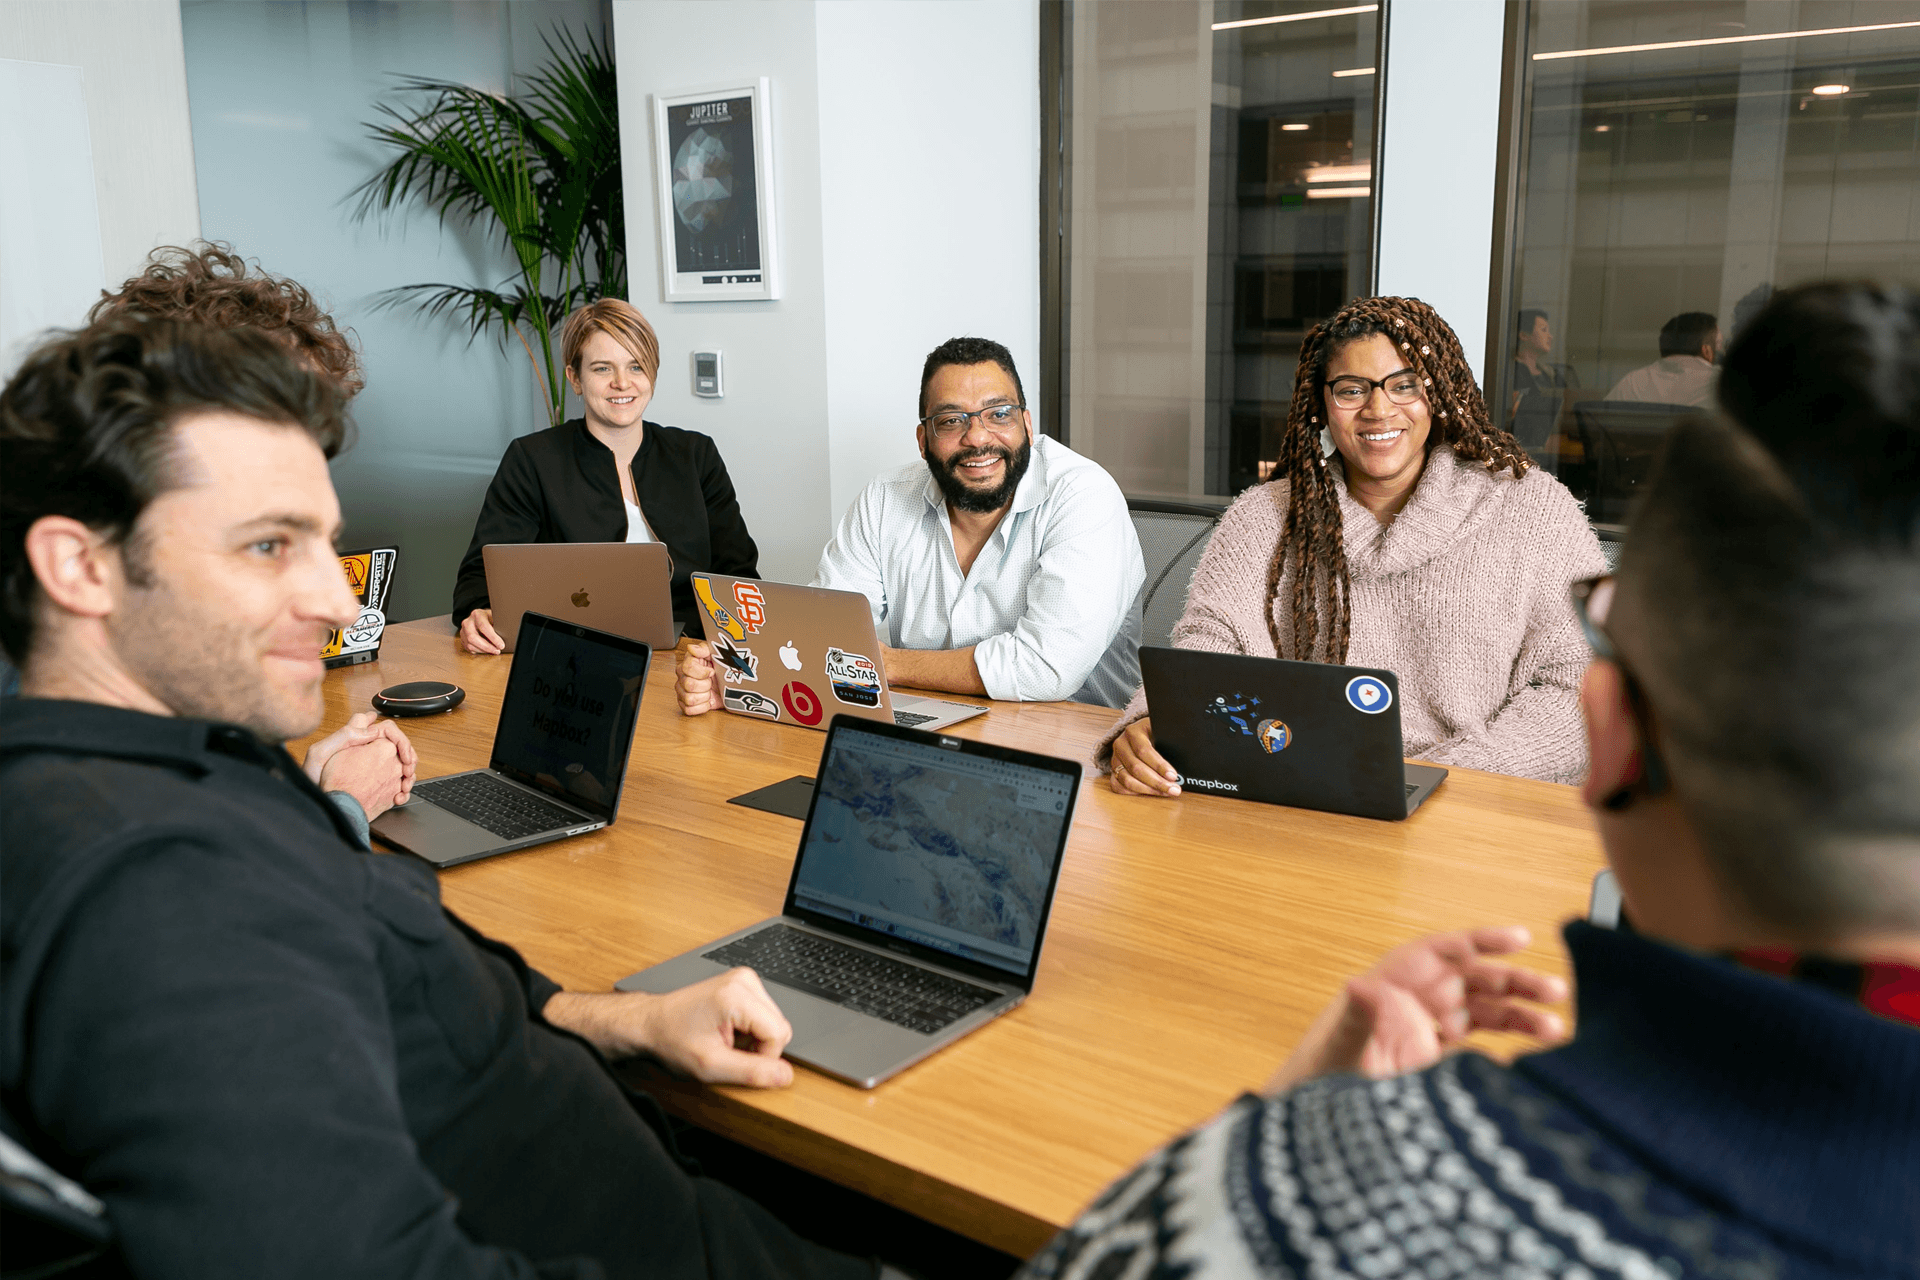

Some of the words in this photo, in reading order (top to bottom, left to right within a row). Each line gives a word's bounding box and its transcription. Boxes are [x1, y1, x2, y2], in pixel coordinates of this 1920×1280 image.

[690, 102, 728, 119] JUPITER
[356, 622, 383, 631] AMERICAN
[533, 676, 551, 698] Do
[580, 695, 605, 717] use
[533, 710, 591, 746] Mapbox?
[1187, 778, 1238, 791] mapbox
